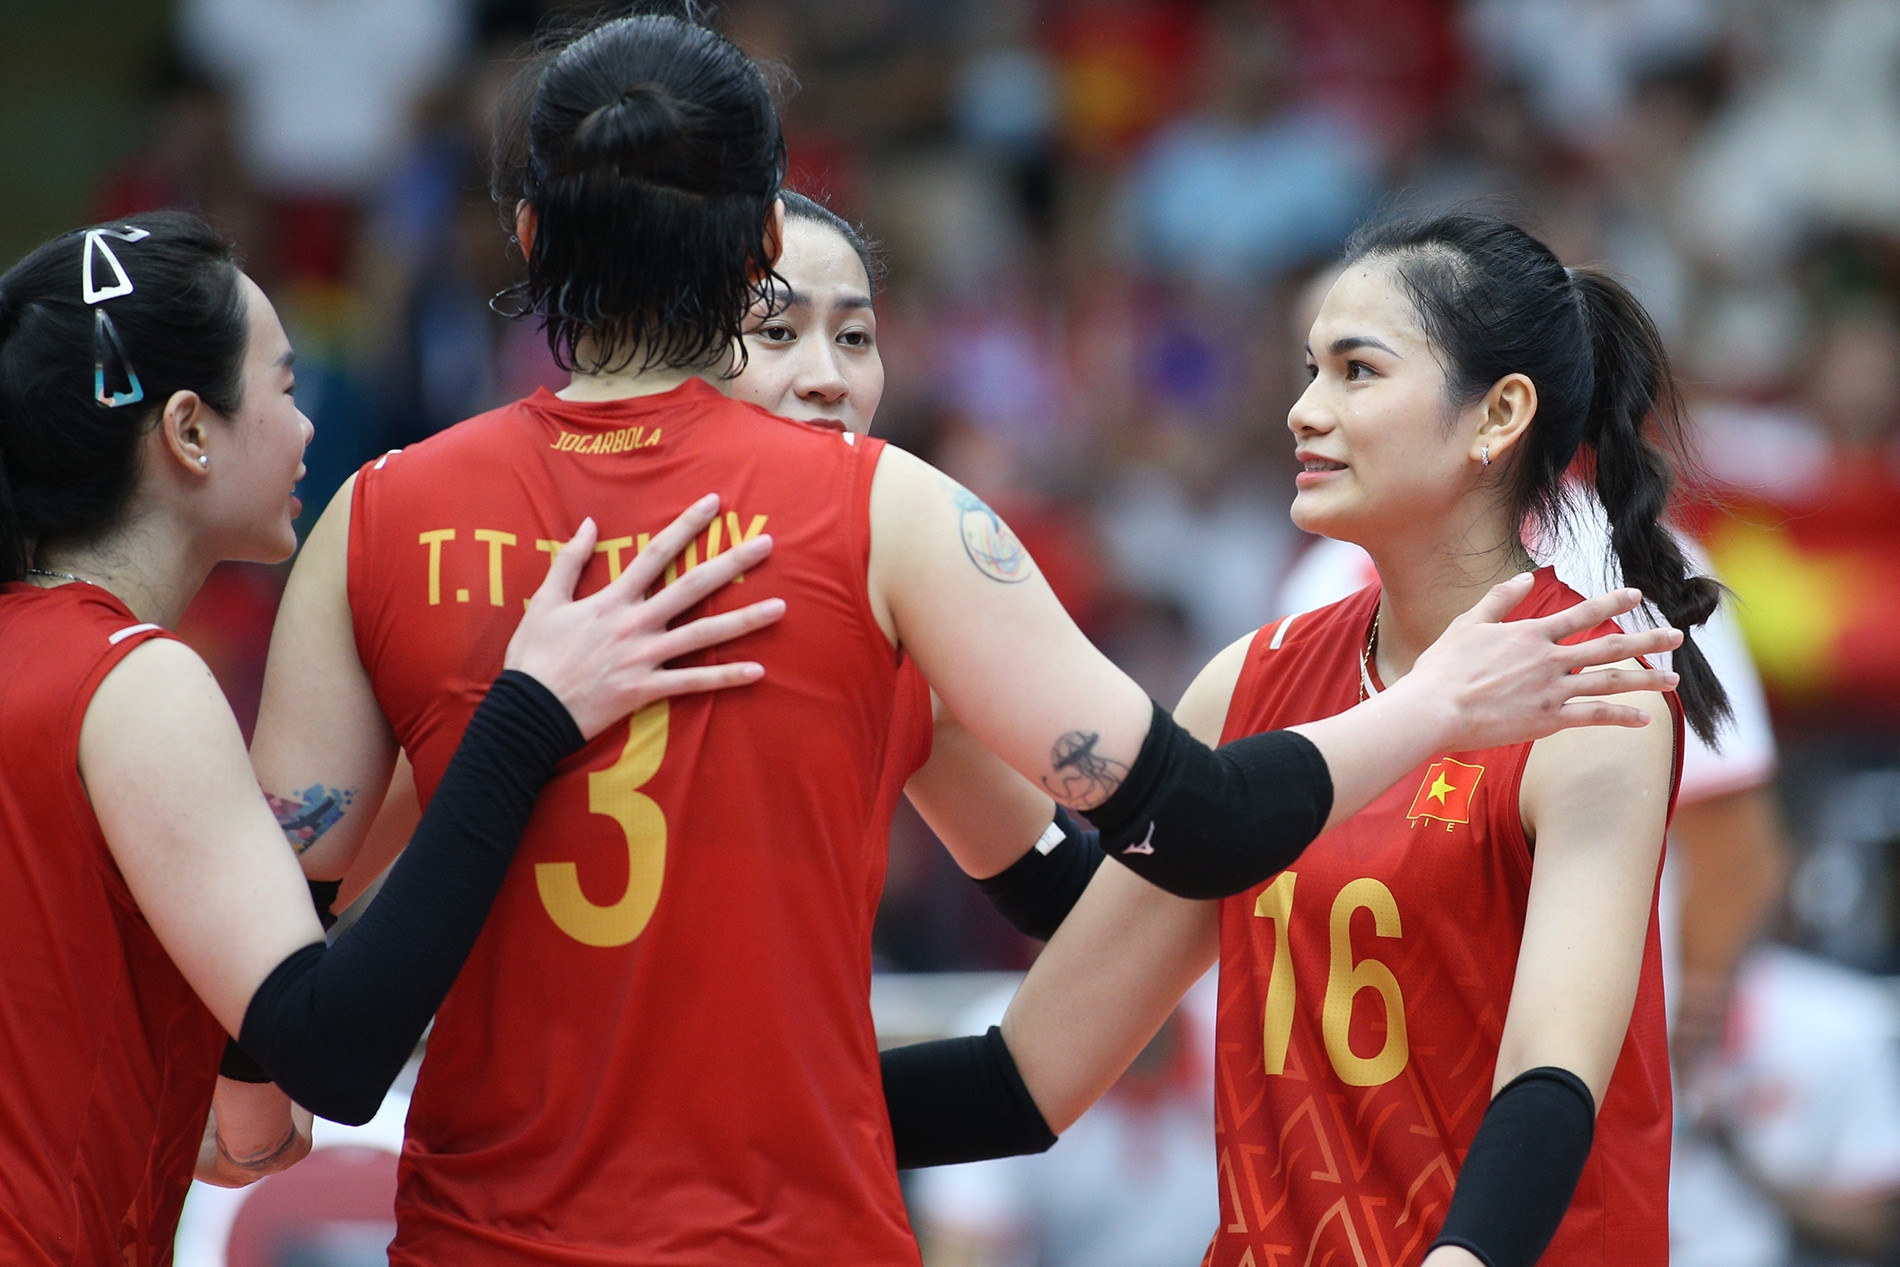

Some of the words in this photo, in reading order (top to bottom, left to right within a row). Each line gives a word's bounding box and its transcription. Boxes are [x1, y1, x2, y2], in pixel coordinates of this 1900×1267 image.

[549, 426, 662, 454] JOGARBOLA
[534, 700, 670, 947] 3
[1410, 817, 1455, 832] VIE
[1253, 870, 1409, 1087] 16
